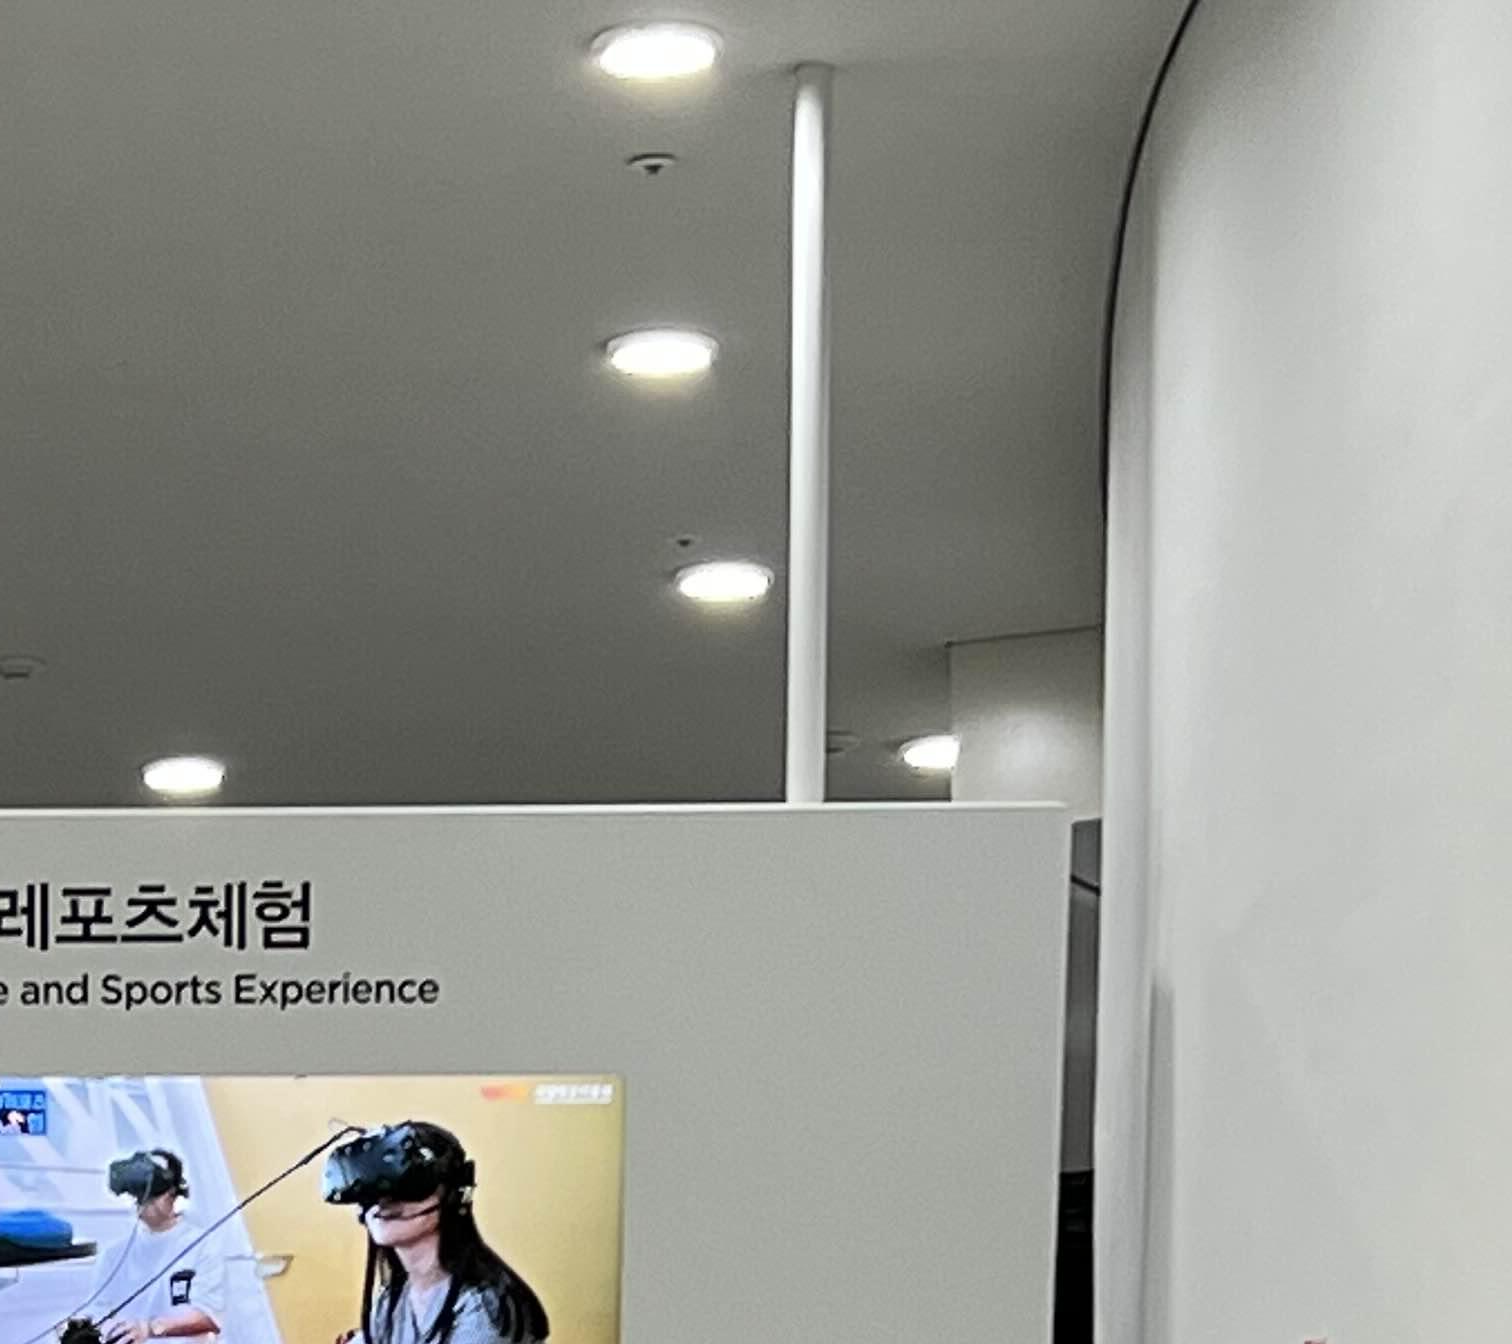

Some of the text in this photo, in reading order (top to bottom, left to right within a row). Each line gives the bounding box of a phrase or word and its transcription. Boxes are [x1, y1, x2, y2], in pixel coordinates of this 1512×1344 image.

[21, 973, 88, 1006] and
[101, 974, 221, 1011] Sports
[234, 972, 440, 1011] Experience
